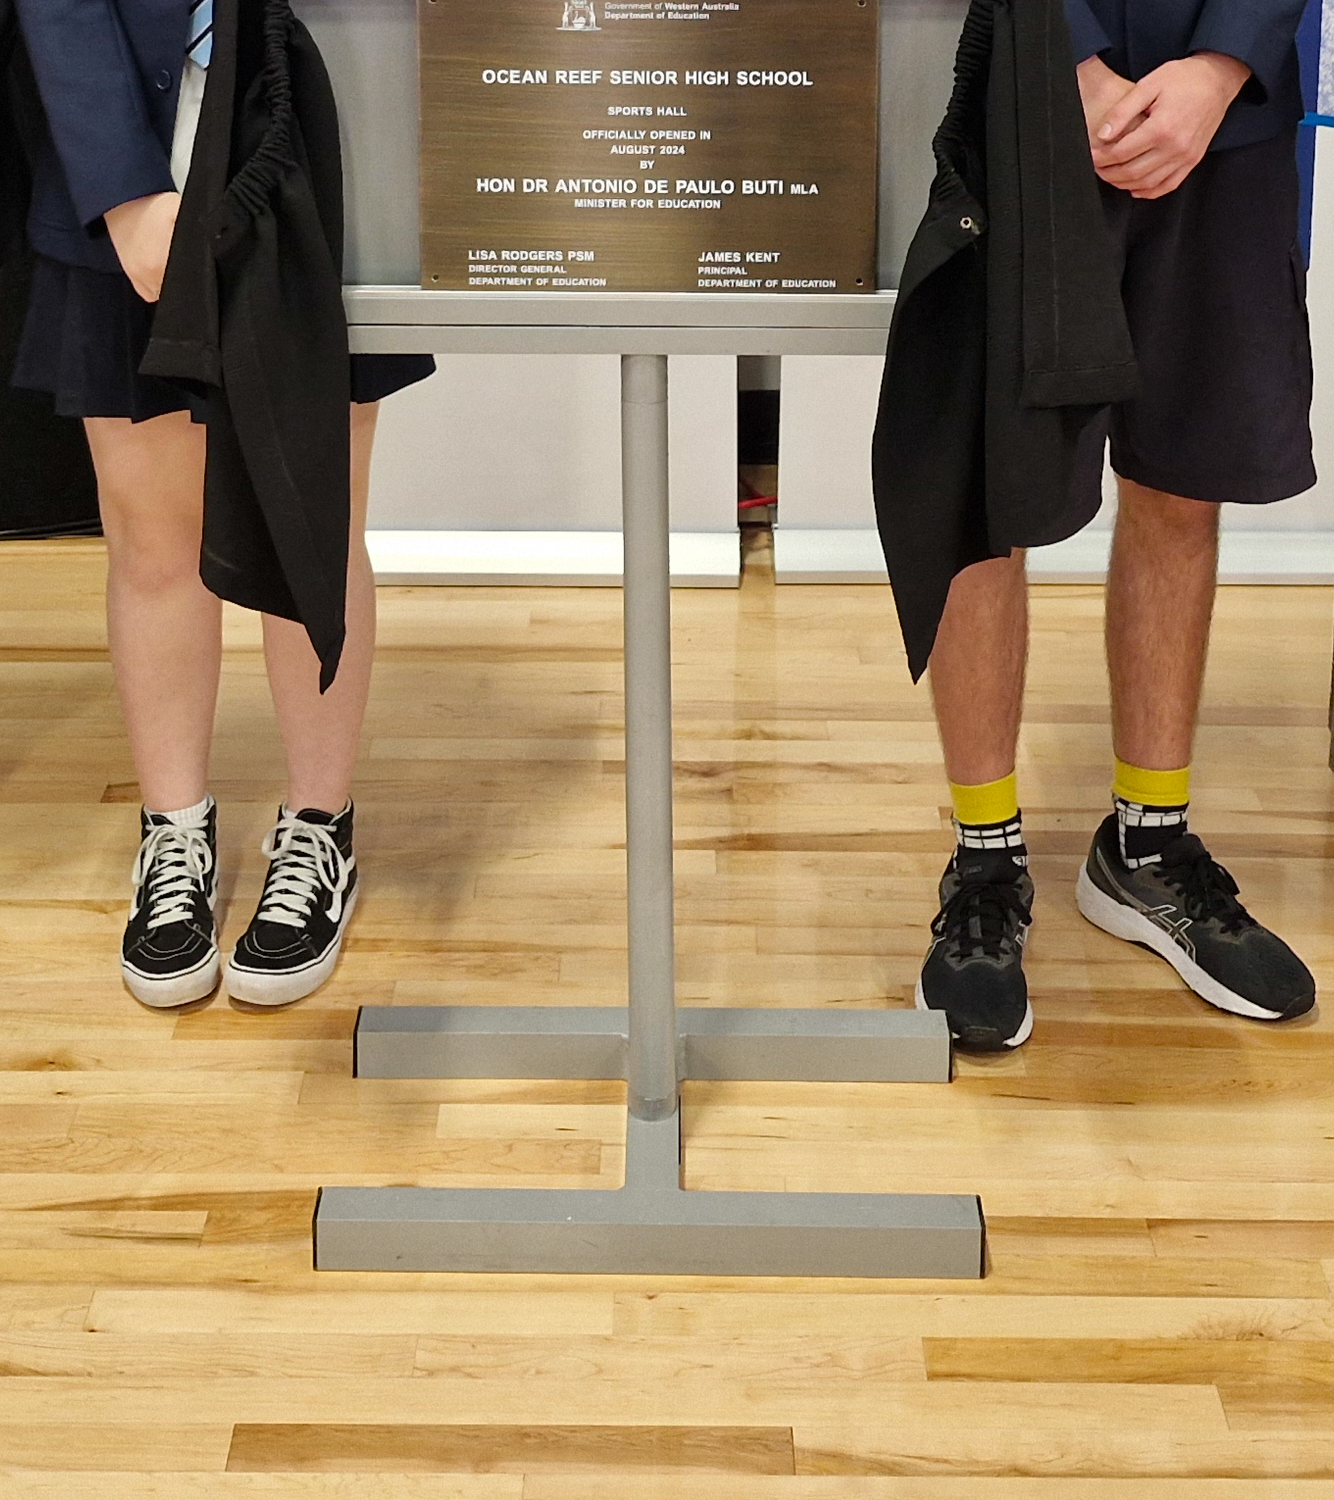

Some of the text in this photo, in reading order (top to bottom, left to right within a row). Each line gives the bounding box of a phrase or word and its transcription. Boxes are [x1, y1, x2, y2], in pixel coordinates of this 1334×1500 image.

[605, 2, 653, 12] Government
[664, 2, 700, 12] Western
[702, 2, 739, 10] Australia
[605, 11, 653, 20] Department
[483, 70, 813, 85] OCEAN REEF SENIOR HIGH SCHOOL
[608, 107, 686, 117] SPORTS HALL
[583, 130, 710, 139] OFFICIALLY OPENED IN
[610, 145, 686, 155] AUGUST 2024
[640, 161, 654, 169] BY
[477, 179, 818, 194] HON DR ANTONIO DE PAULO BUTI MLA
[575, 199, 722, 208] MINISTER FOR EDUCATION
[469, 250, 594, 261] LISA RODGERS PSM
[698, 252, 780, 262] JAMES KENT
[521, 265, 567, 273] GENERAL
[552, 278, 606, 286] EDUCATION
[698, 279, 762, 287] DEPARTMENT
